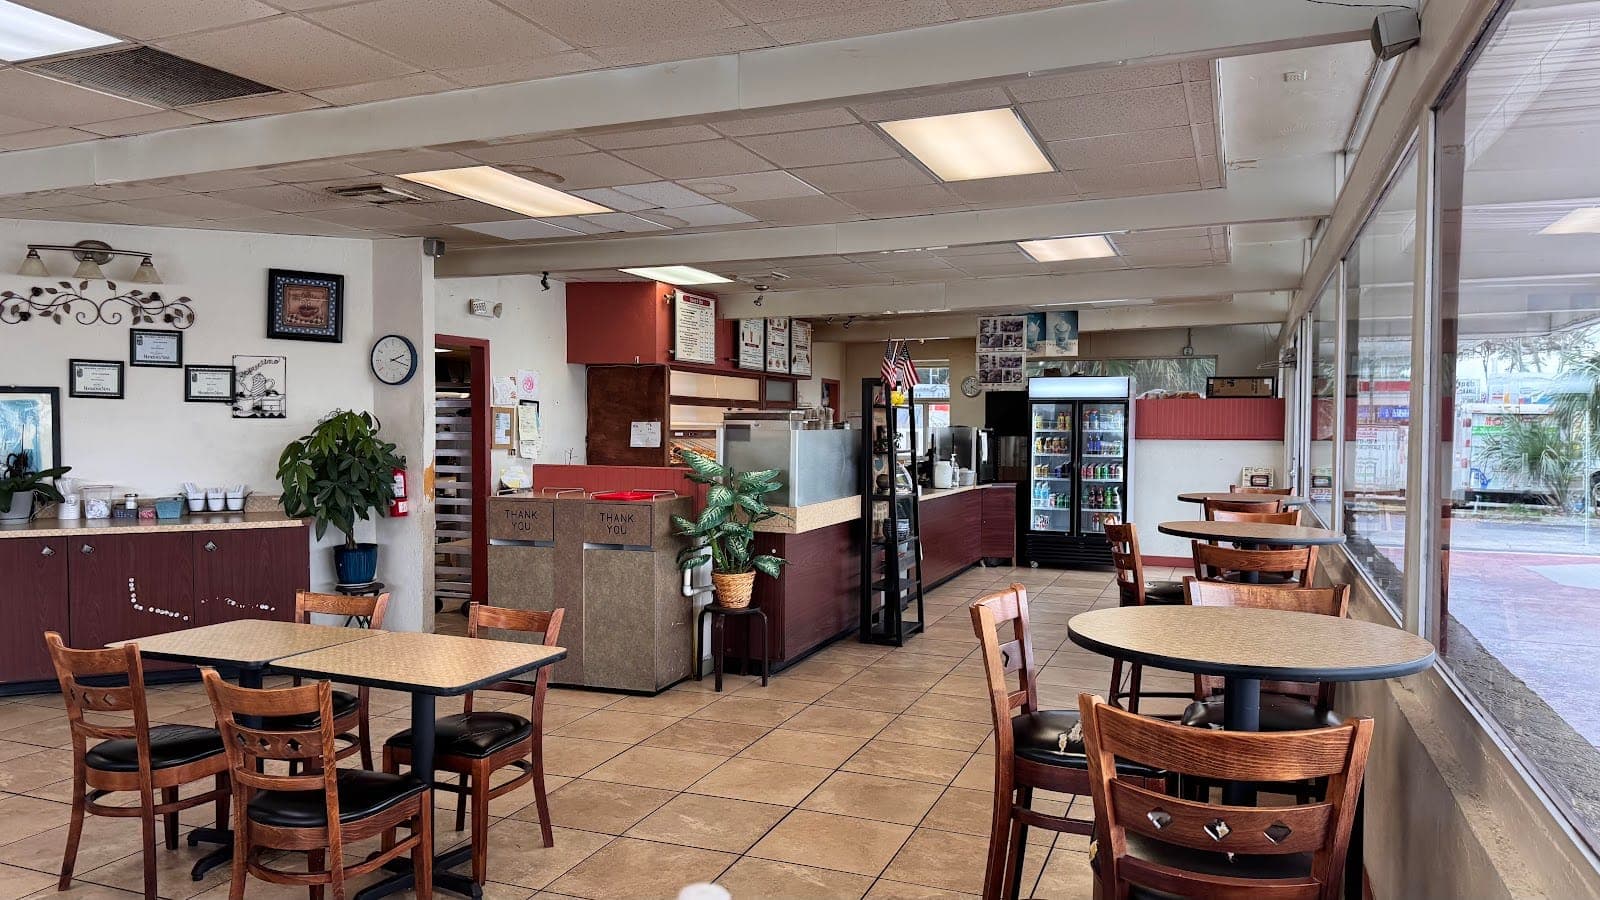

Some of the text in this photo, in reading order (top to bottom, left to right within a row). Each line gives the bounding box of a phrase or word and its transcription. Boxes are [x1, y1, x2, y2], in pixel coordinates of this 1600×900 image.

[504, 509, 538, 520] THANK
[600, 512, 635, 523] THANK
[511, 521, 531, 531] YOU
[606, 524, 627, 535] YOU
